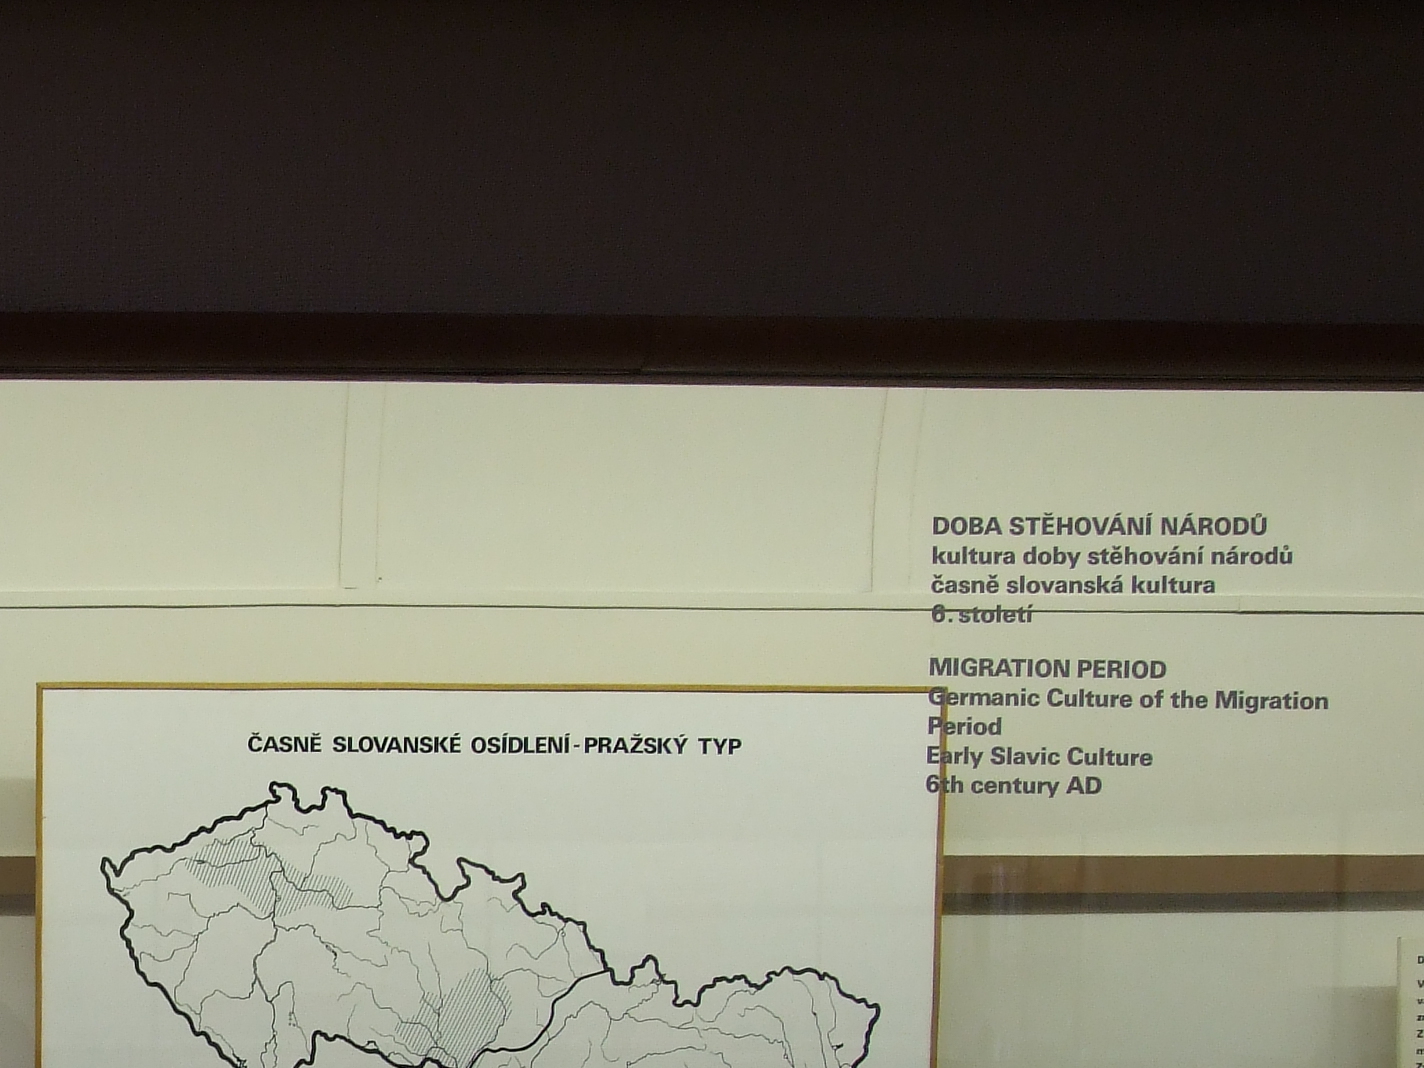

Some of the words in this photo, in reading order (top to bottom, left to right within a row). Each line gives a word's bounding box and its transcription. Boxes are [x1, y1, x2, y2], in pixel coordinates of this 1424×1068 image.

[933, 517, 1003, 535] DOBA
[1009, 512, 1153, 536] STĚHOVÁNÍ
[1161, 512, 1267, 536] NÁRODŮ
[933, 546, 1015, 565] kultura
[1023, 546, 1081, 569] doby
[1087, 545, 1204, 565] stěhování
[1211, 545, 1293, 565] národů
[931, 574, 999, 594] časně
[1006, 575, 1123, 594] slovanská
[1132, 575, 1215, 594] kultura
[931, 604, 954, 623] 6.
[958, 604, 1034, 623] století
[930, 657, 1070, 678] MIGRATION
[1077, 660, 1167, 679] PERIOD
[928, 687, 1040, 708] Germanic
[1047, 688, 1133, 708] Culture
[1140, 689, 1164, 708] of
[1170, 690, 1208, 709] the
[1215, 690, 1328, 714] Migration
[927, 717, 1002, 735] Period
[248, 732, 322, 752] ČASNĚ
[333, 733, 461, 753] SLOVANSKÉ
[698, 738, 742, 755] TYP
[926, 746, 984, 770] Early
[990, 746, 1060, 765] Slavic
[1067, 747, 1153, 766] Culture
[926, 774, 963, 794] 6th
[971, 778, 1060, 798] century
[1066, 776, 1102, 794] AD
